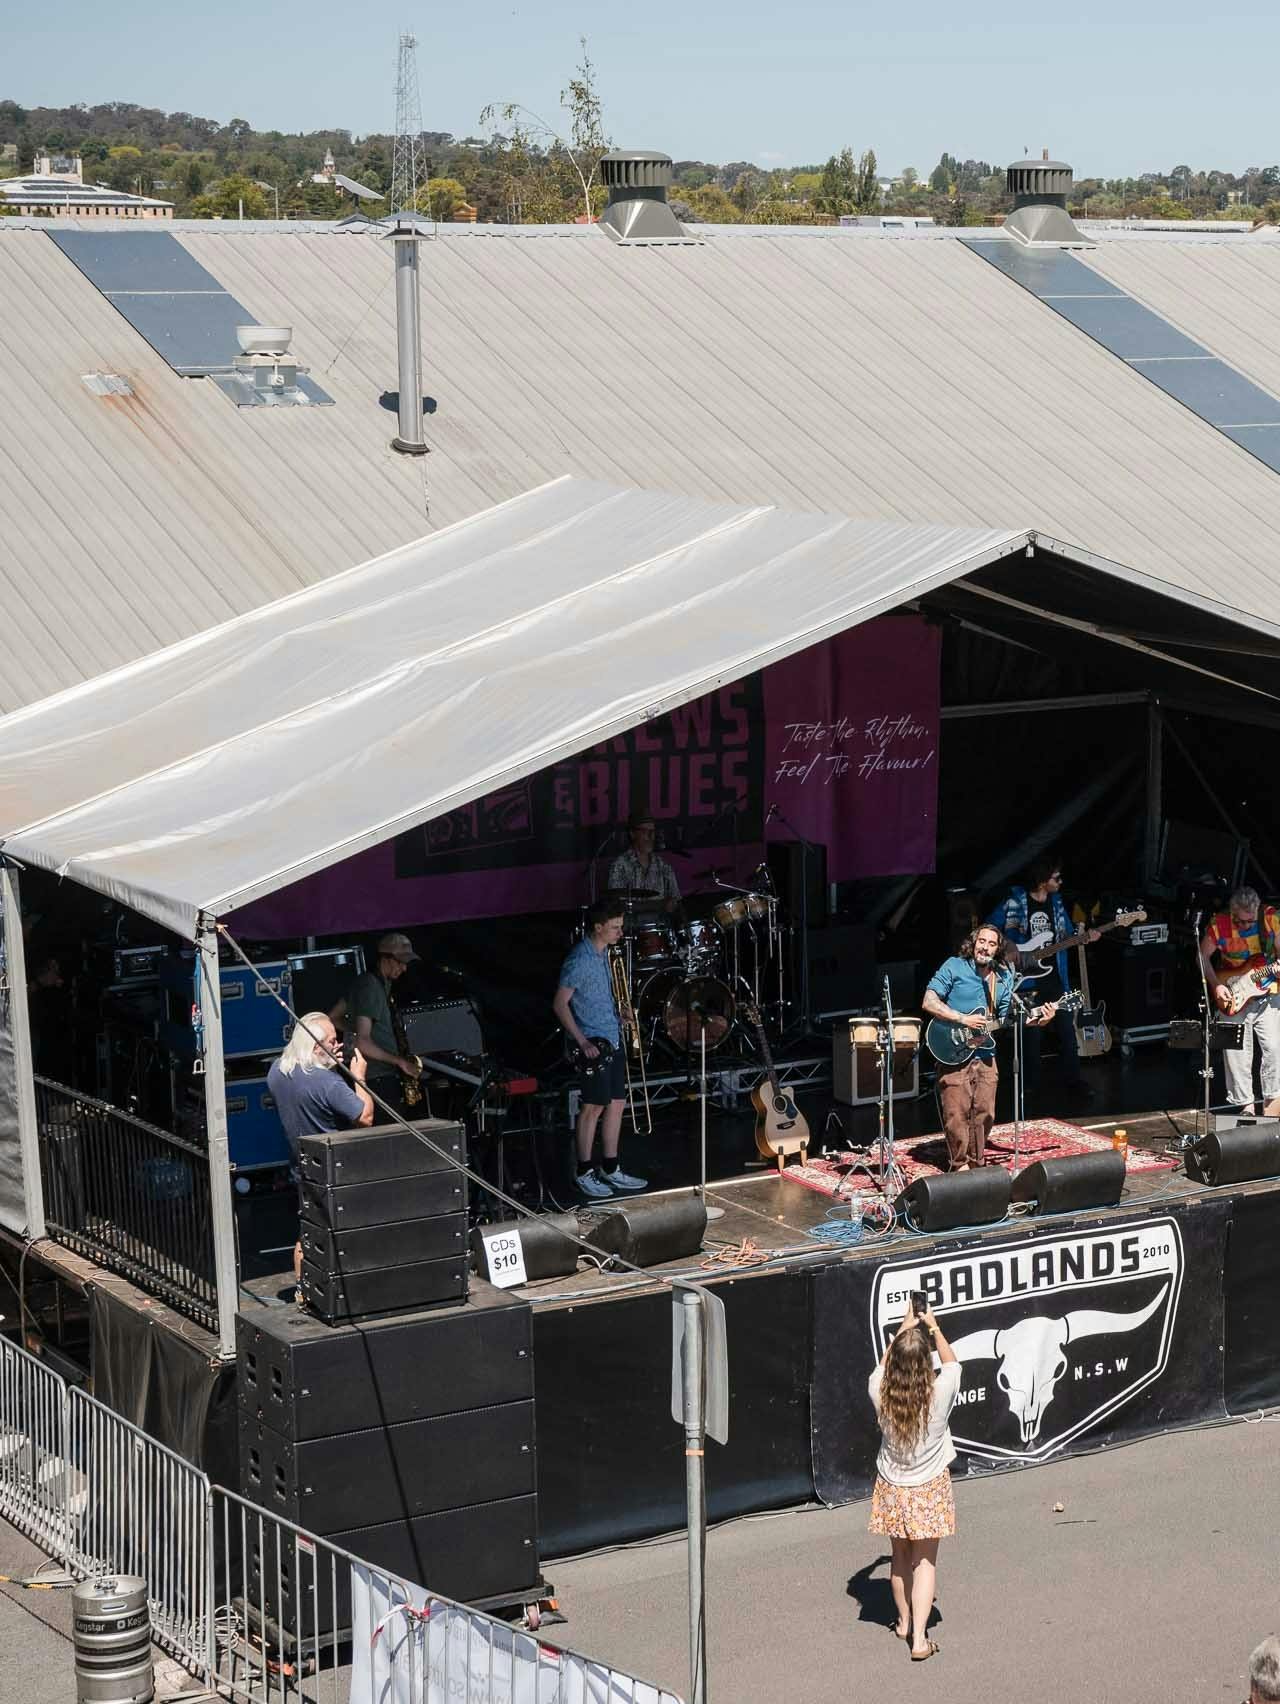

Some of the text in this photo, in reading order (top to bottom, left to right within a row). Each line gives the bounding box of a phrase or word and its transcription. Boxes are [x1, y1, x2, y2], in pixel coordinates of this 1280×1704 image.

[782, 720, 826, 752] Taste
[775, 752, 821, 785] Feel
[858, 748, 935, 781] Flavour!
[580, 750, 749, 826] BLUES
[490, 1239, 516, 1253] CDs
[494, 1253, 517, 1270] $10
[920, 1236, 1141, 1307] BADLANDS
[1142, 1245, 1171, 1259] 2010
[1074, 1357, 1129, 1380] N.S.W
